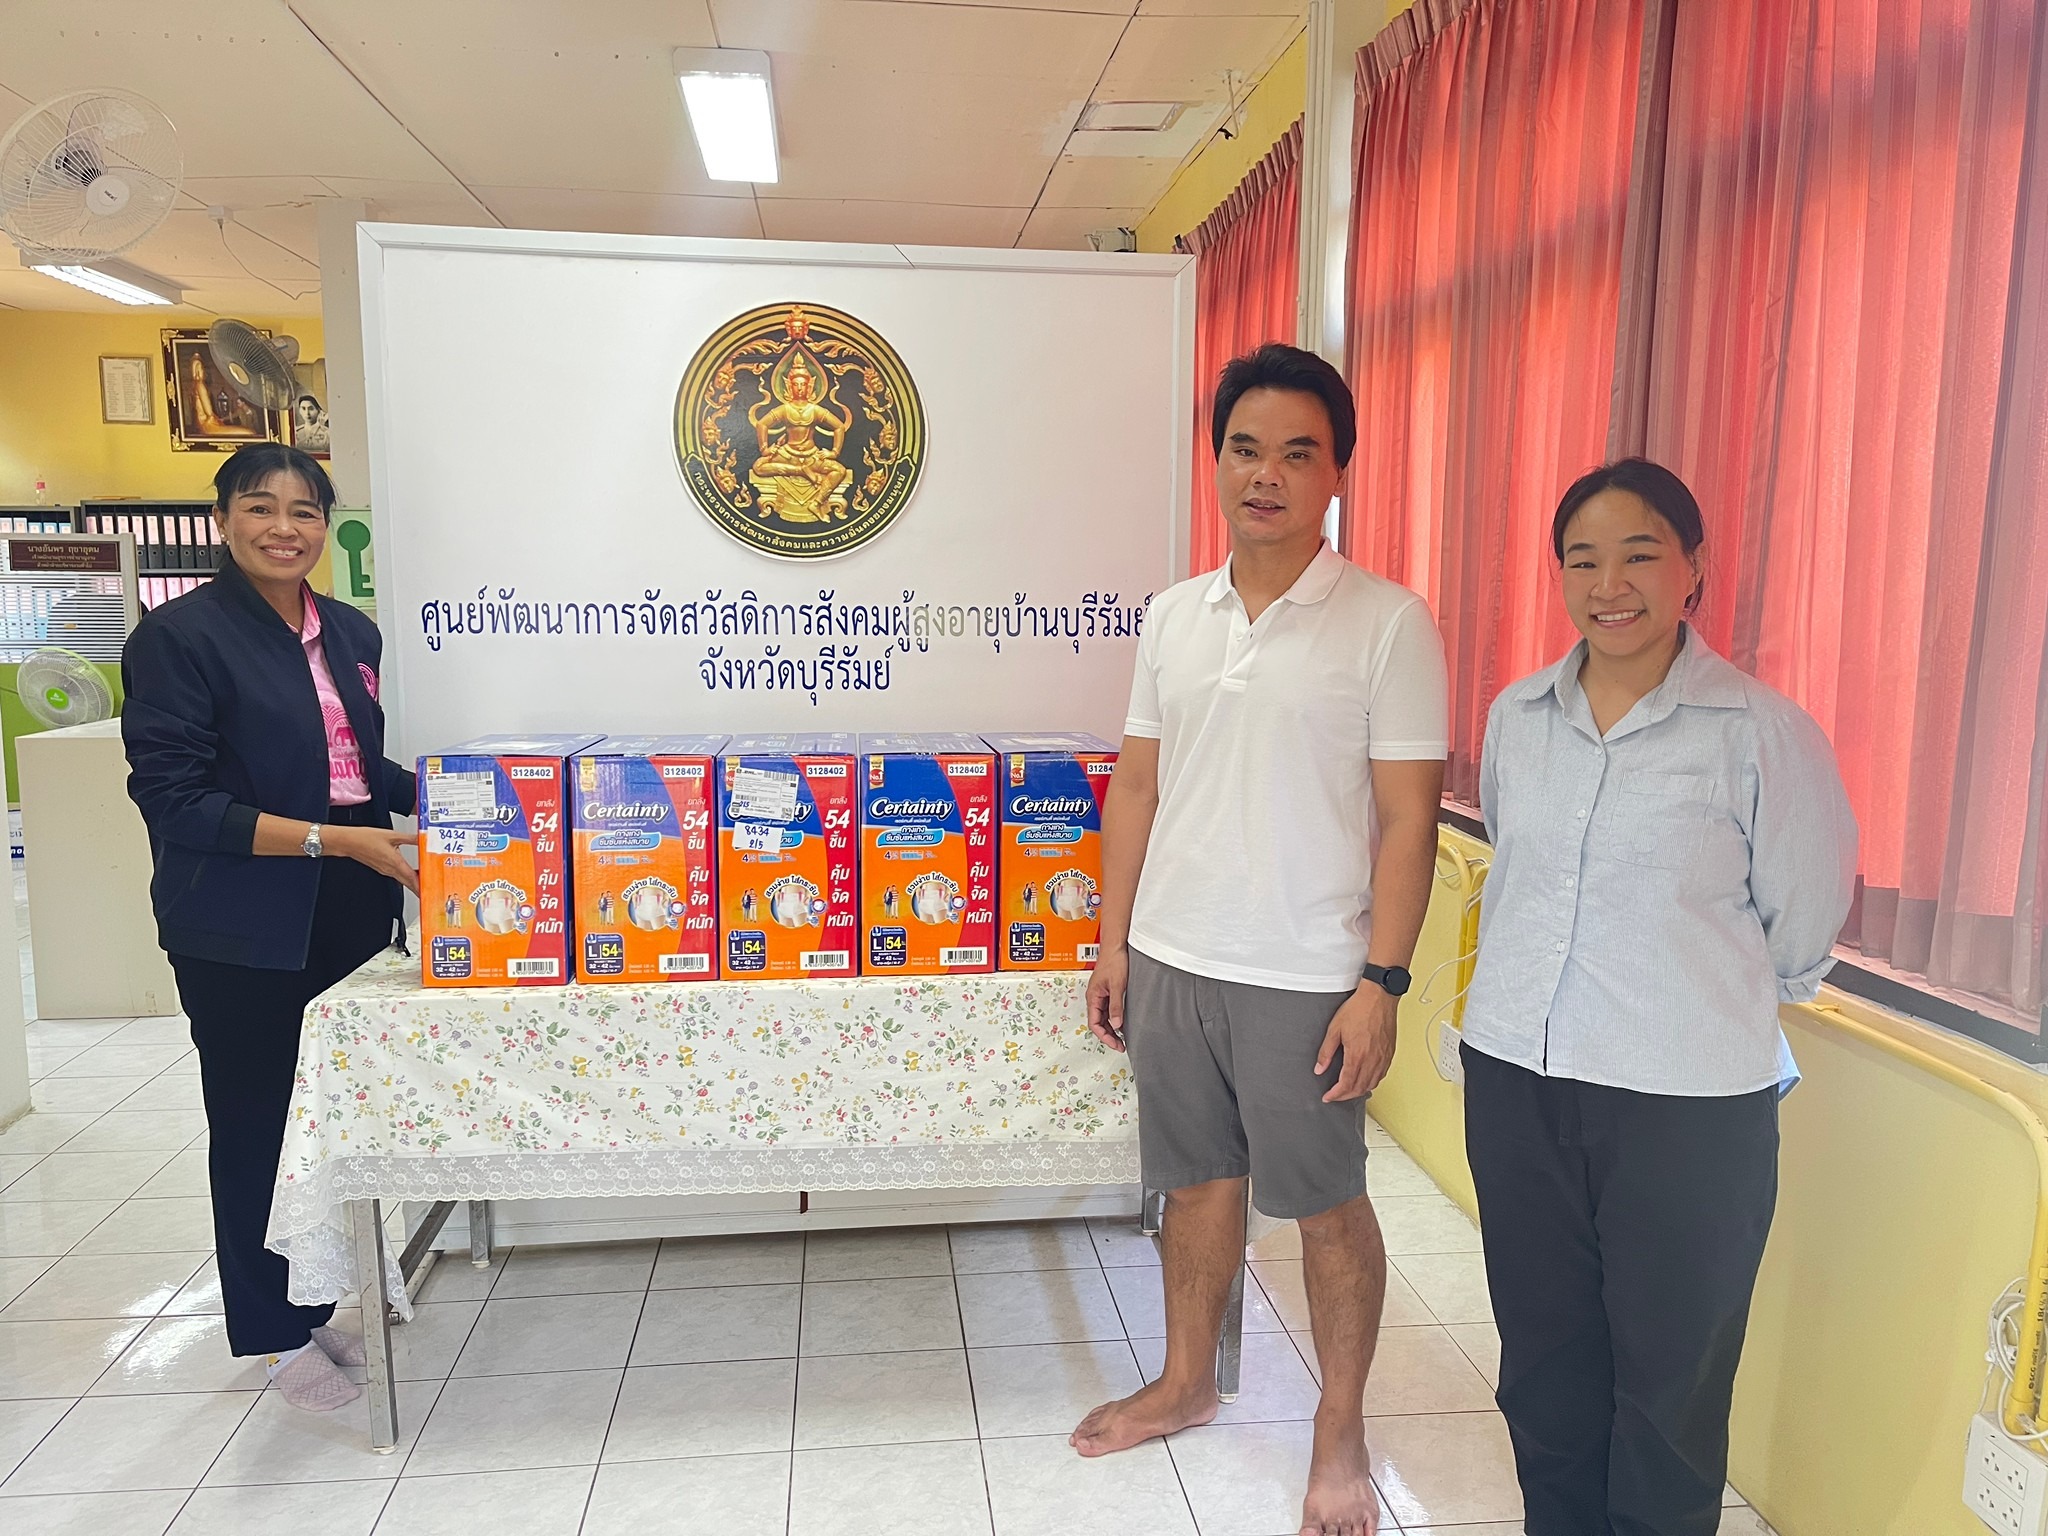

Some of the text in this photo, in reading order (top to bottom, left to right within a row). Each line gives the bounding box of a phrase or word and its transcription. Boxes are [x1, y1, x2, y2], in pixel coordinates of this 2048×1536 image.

[694, 471, 906, 550] กระทรวงการพัฒนาสังคมและความมั่นคงของมนุษย์
[699, 645, 893, 706] จังหวัดบุรีรัมย์
[513, 768, 551, 777] 3128402
[665, 768, 702, 776] 3128402
[808, 767, 844, 775] 3128402
[949, 766, 985, 774] 3128402
[1088, 764, 1114, 773] 31284
[536, 799, 555, 807] ยกลัง
[687, 797, 706, 805] ยกลัง
[829, 797, 847, 805] ยกลัง
[970, 795, 987, 803] ยกลัง
[1012, 797, 1091, 816] Certainty
[583, 802, 669, 821] Certainty
[872, 799, 953, 818] Certainty
[531, 813, 557, 833] 54
[683, 810, 709, 830] 54
[825, 809, 850, 829] 54
[965, 808, 990, 827] 54
[439, 829, 466, 840] 8434
[744, 825, 770, 836] 8434
[969, 829, 986, 846] ชิ้น
[444, 841, 464, 853] 4/5
[536, 834, 554, 852] ชิ้น
[687, 833, 705, 850] ชิ้น
[829, 831, 846, 849] ชิ้น
[689, 866, 709, 888] คุ้ม
[830, 863, 850, 885] คุ้ม
[970, 861, 989, 882] คุ้ม
[538, 869, 557, 891] คุ้ม
[765, 877, 790, 897] สวมง่าย
[906, 874, 931, 894] สวมง่าย
[1046, 871, 1069, 891] สวมง่าย
[471, 882, 496, 902] สวมง่าย
[622, 879, 648, 899] สวมง่าย
[832, 888, 849, 903] จัด
[971, 885, 988, 901] จัด
[539, 894, 557, 909] จัด
[690, 890, 709, 906] จัด
[686, 914, 714, 930] หนัก
[827, 911, 854, 927] หนัก
[966, 908, 993, 924] หนัก
[535, 918, 563, 934] หนัก
[731, 941, 761, 954] L 54
[873, 937, 902, 950] L 54
[1012, 933, 1040, 946] L 54
[435, 947, 466, 961] L 54
[588, 944, 618, 957] L 54
